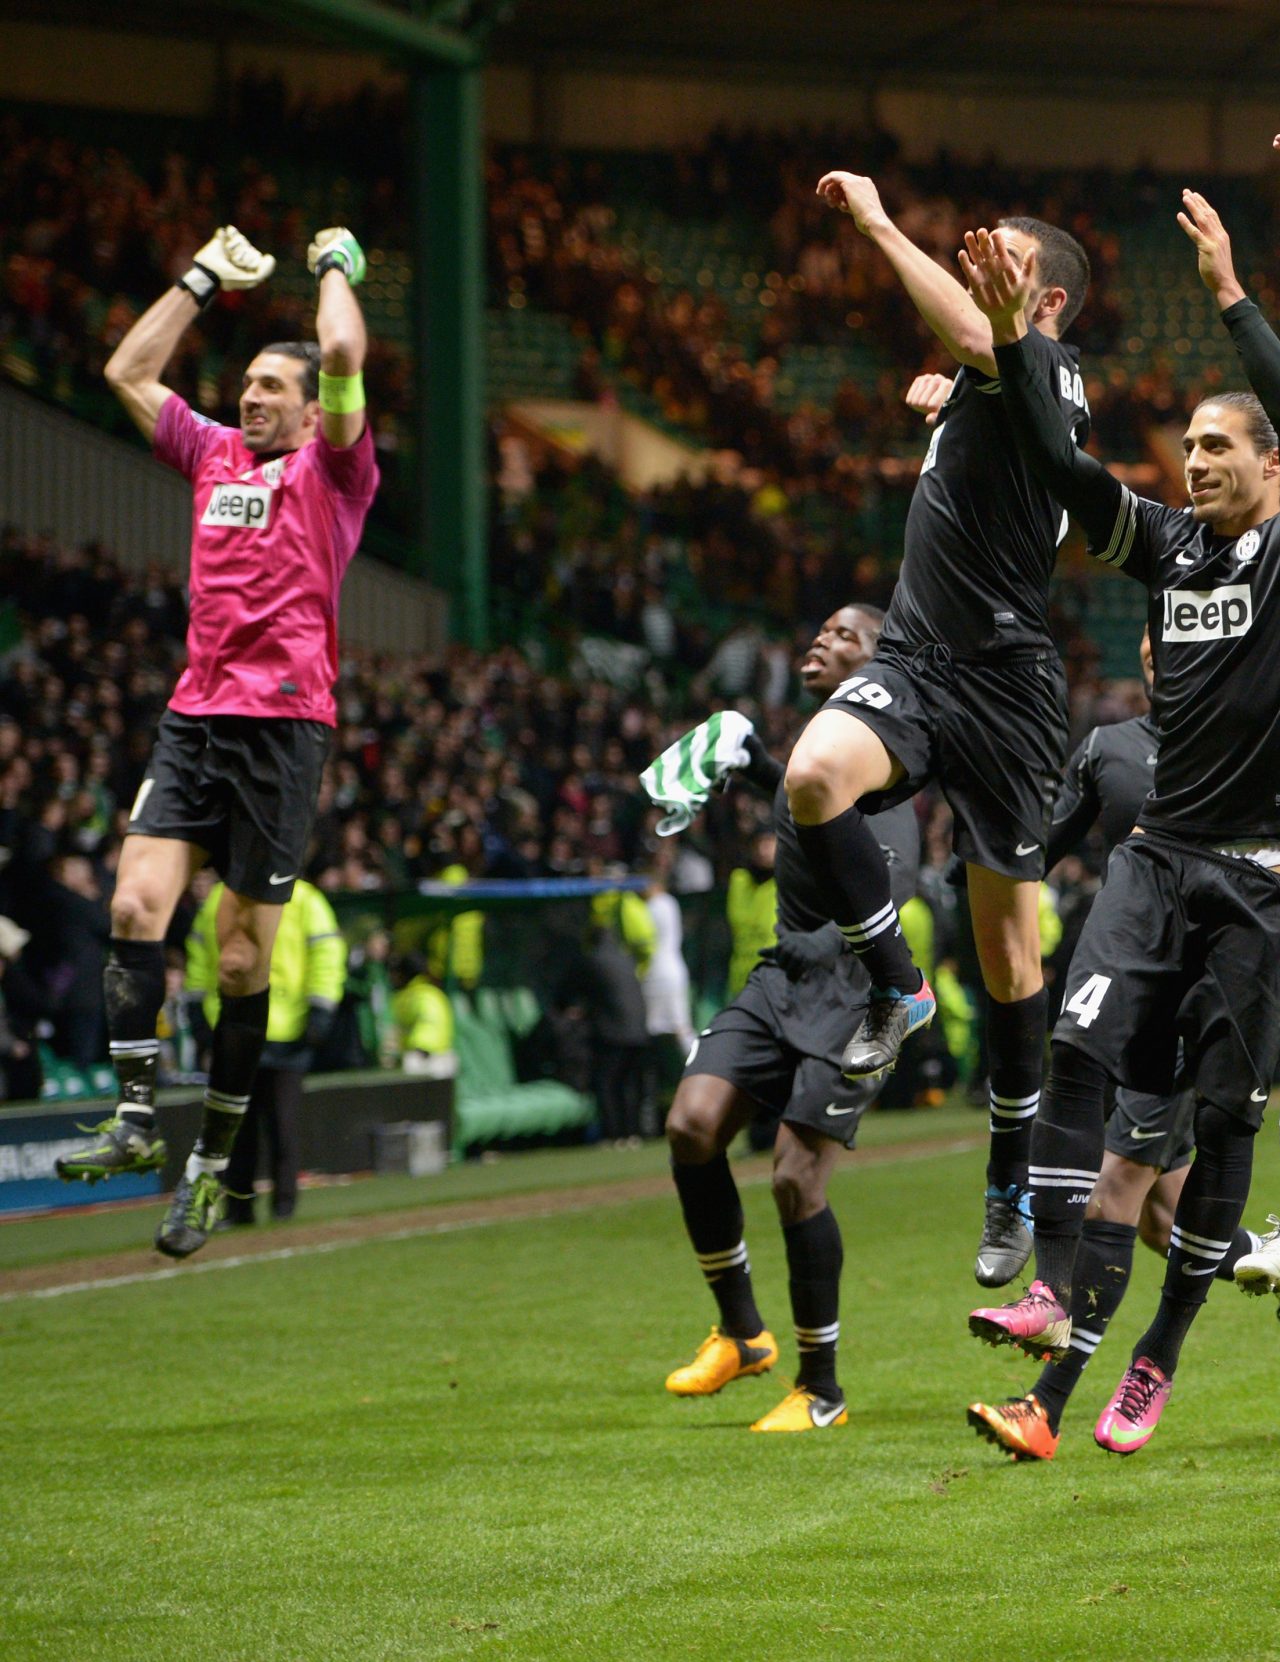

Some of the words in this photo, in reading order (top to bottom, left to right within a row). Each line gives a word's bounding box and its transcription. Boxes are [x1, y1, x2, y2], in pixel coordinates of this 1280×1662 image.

[209, 486, 265, 525] Jeep
[1164, 593, 1248, 636] Jeep
[1065, 973, 1113, 1029] 4
